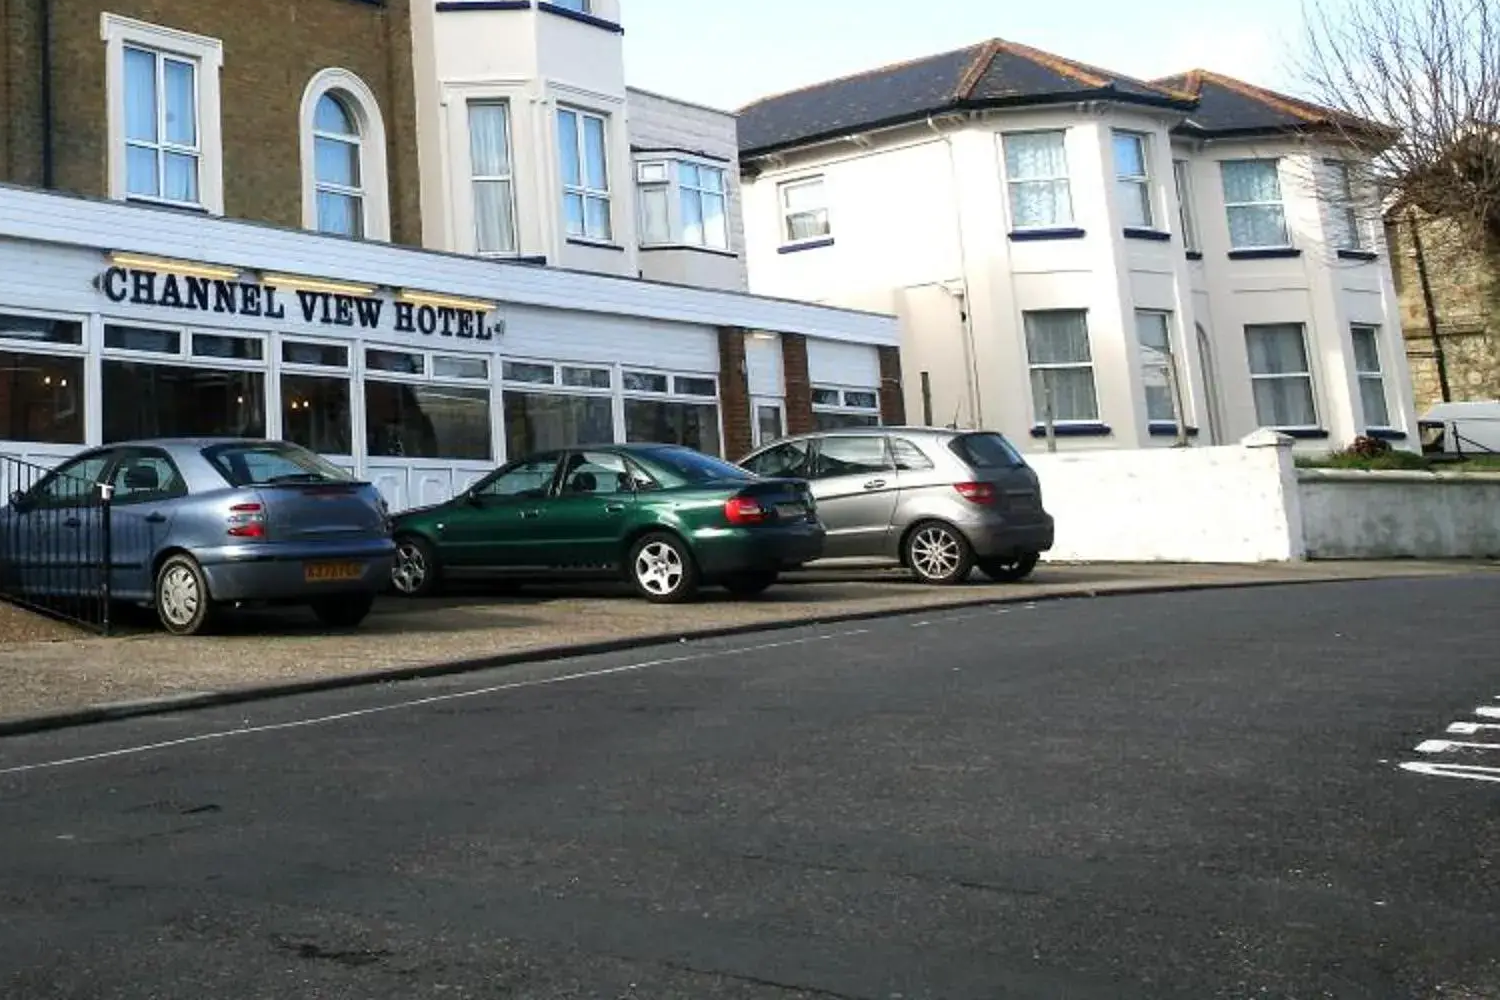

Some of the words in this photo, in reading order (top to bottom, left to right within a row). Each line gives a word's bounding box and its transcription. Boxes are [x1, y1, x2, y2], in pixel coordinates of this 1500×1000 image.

[105, 266, 284, 319] CHANNEL
[296, 290, 384, 329] VIEW
[394, 301, 492, 340] HOTEL
